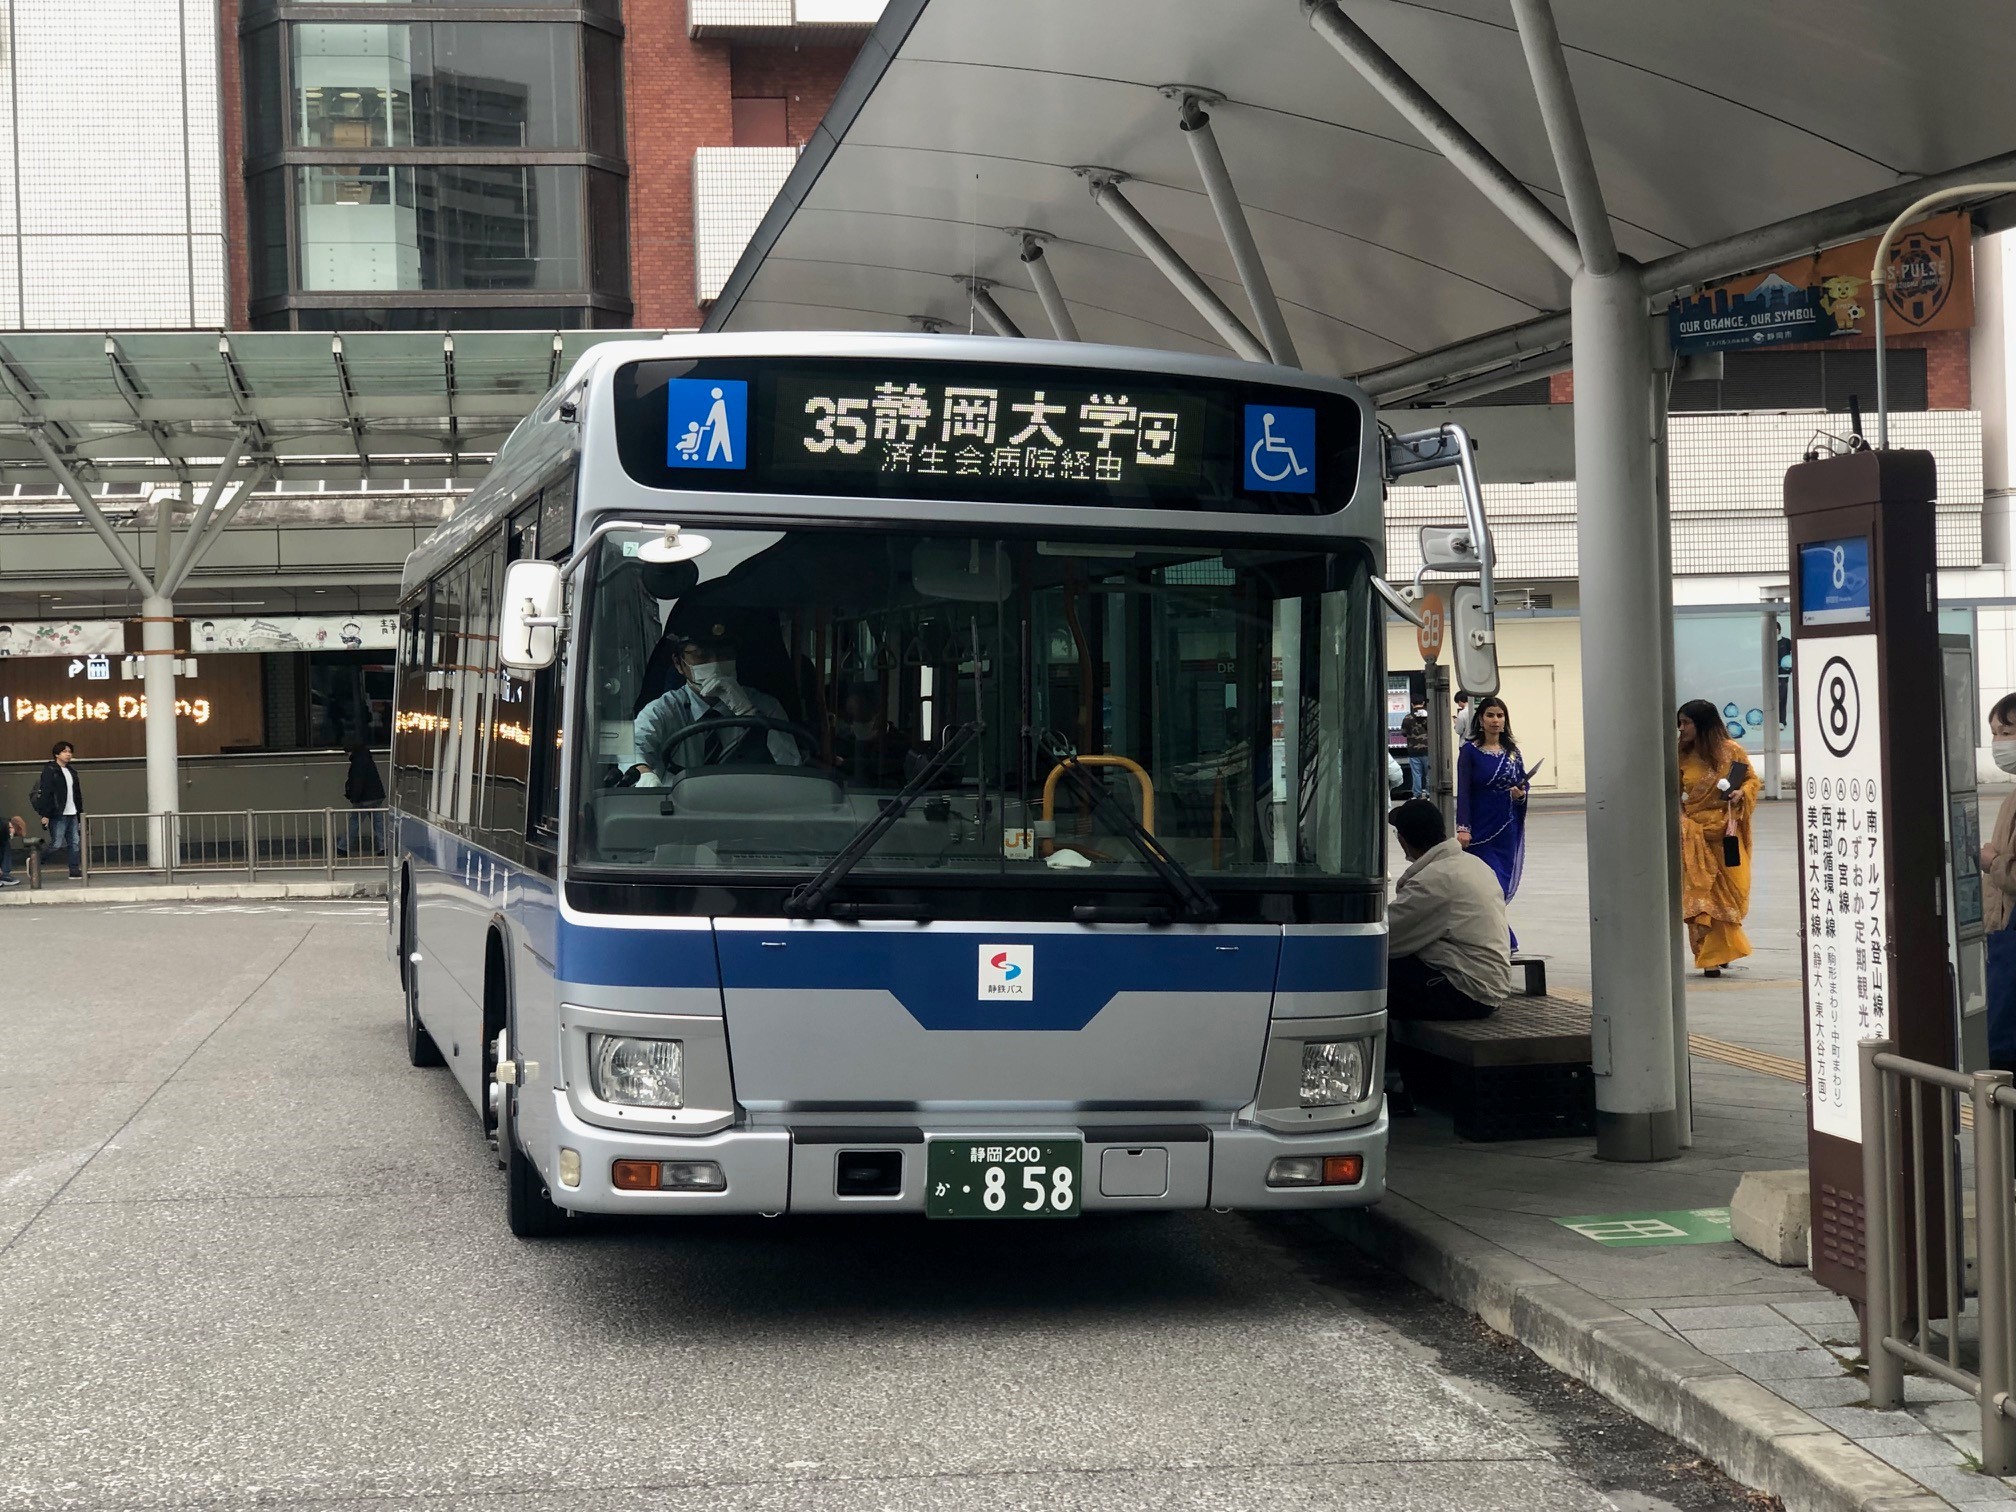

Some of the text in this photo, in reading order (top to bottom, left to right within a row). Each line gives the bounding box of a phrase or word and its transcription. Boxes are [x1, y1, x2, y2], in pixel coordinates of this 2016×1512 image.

[1679, 307, 1817, 333] OUR ORANGE, OUR SYMBOL
[802, 381, 1137, 454] 35 静岡大学
[881, 440, 1123, 482] 済生会病院経由
[1833, 545, 1845, 590] 8
[15, 694, 211, 724] Parche Ding
[1836, 807, 1850, 915] 井の宮線
[1851, 809, 1870, 1039] しずおか定期観光
[988, 984, 1023, 994] 静鉄バス
[970, 1146, 1040, 1163] 静岡200
[935, 1182, 951, 1198] か
